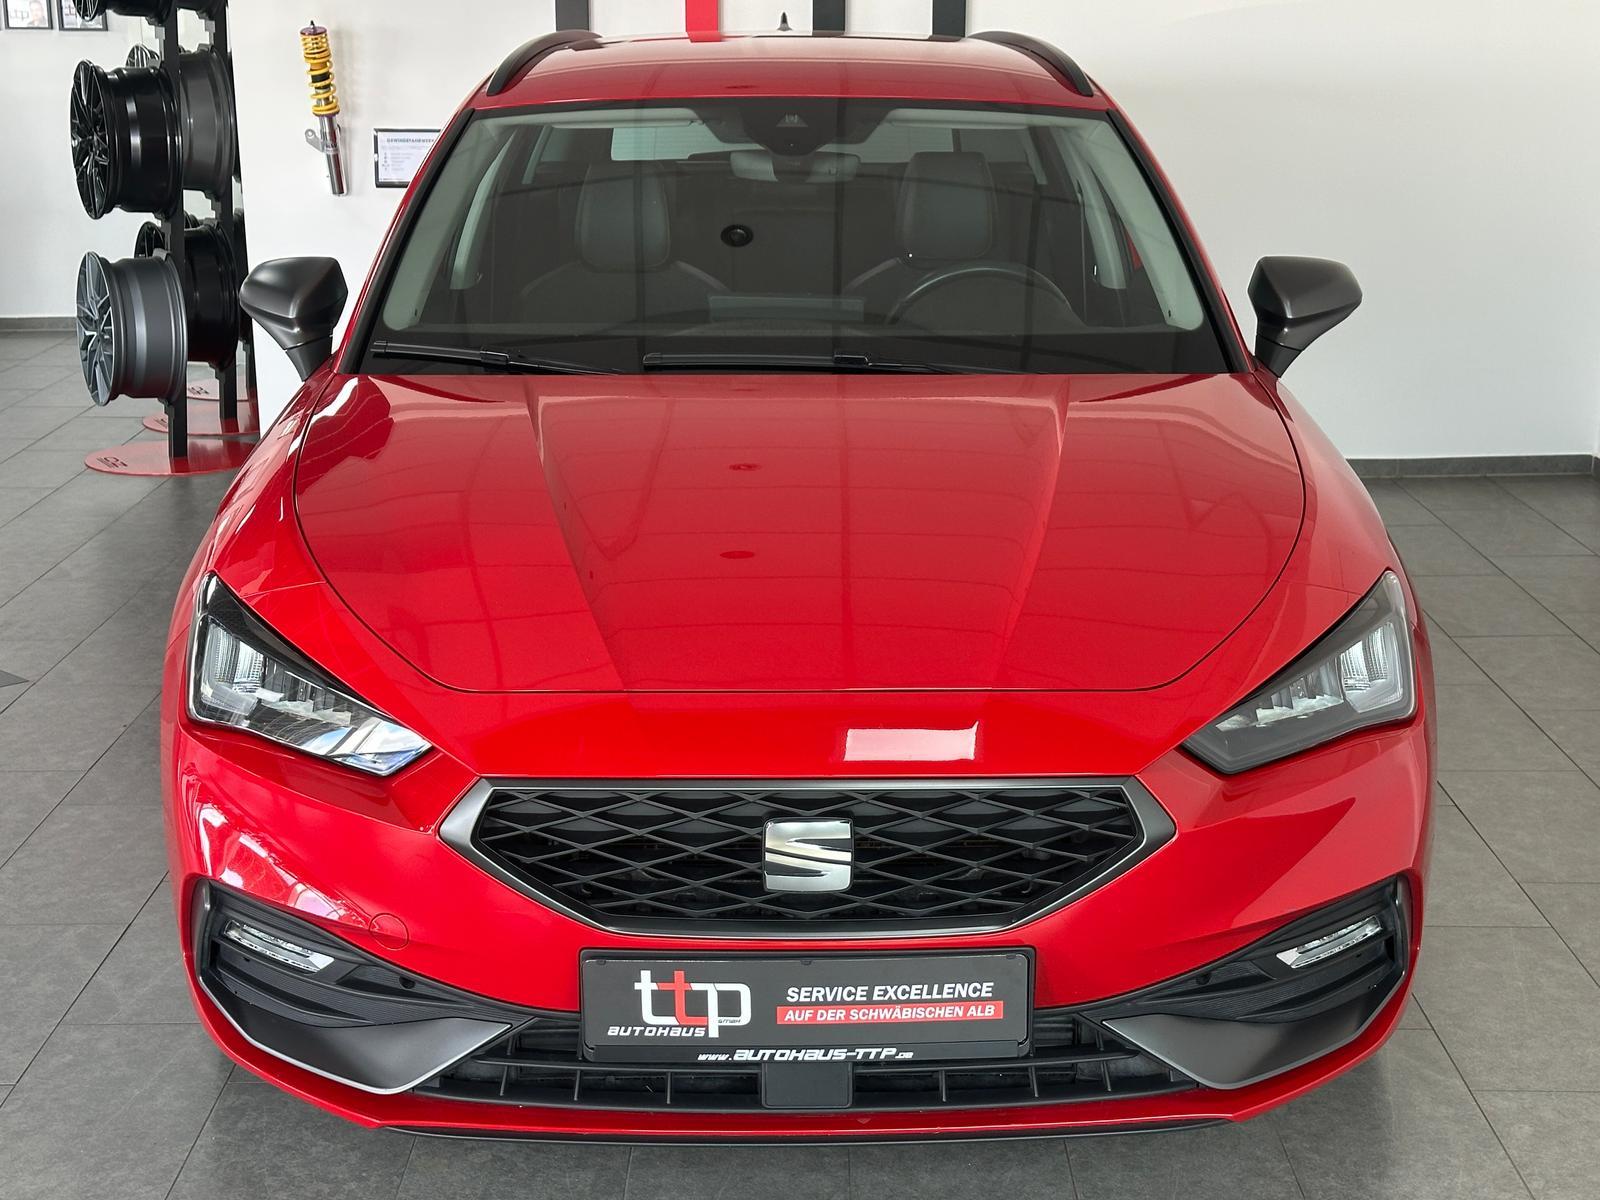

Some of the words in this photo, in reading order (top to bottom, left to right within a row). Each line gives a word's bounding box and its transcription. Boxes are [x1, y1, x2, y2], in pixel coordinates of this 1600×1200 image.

[786, 986, 868, 1002] SERVICE
[873, 982, 994, 1000] EXCELLENCE
[634, 970, 752, 1038] ttp
[784, 1009, 814, 1022] AUF
[816, 1009, 846, 1021] DER
[849, 1005, 964, 1020] SCHWÄBISCHEN
[967, 1004, 996, 1017] ALB
